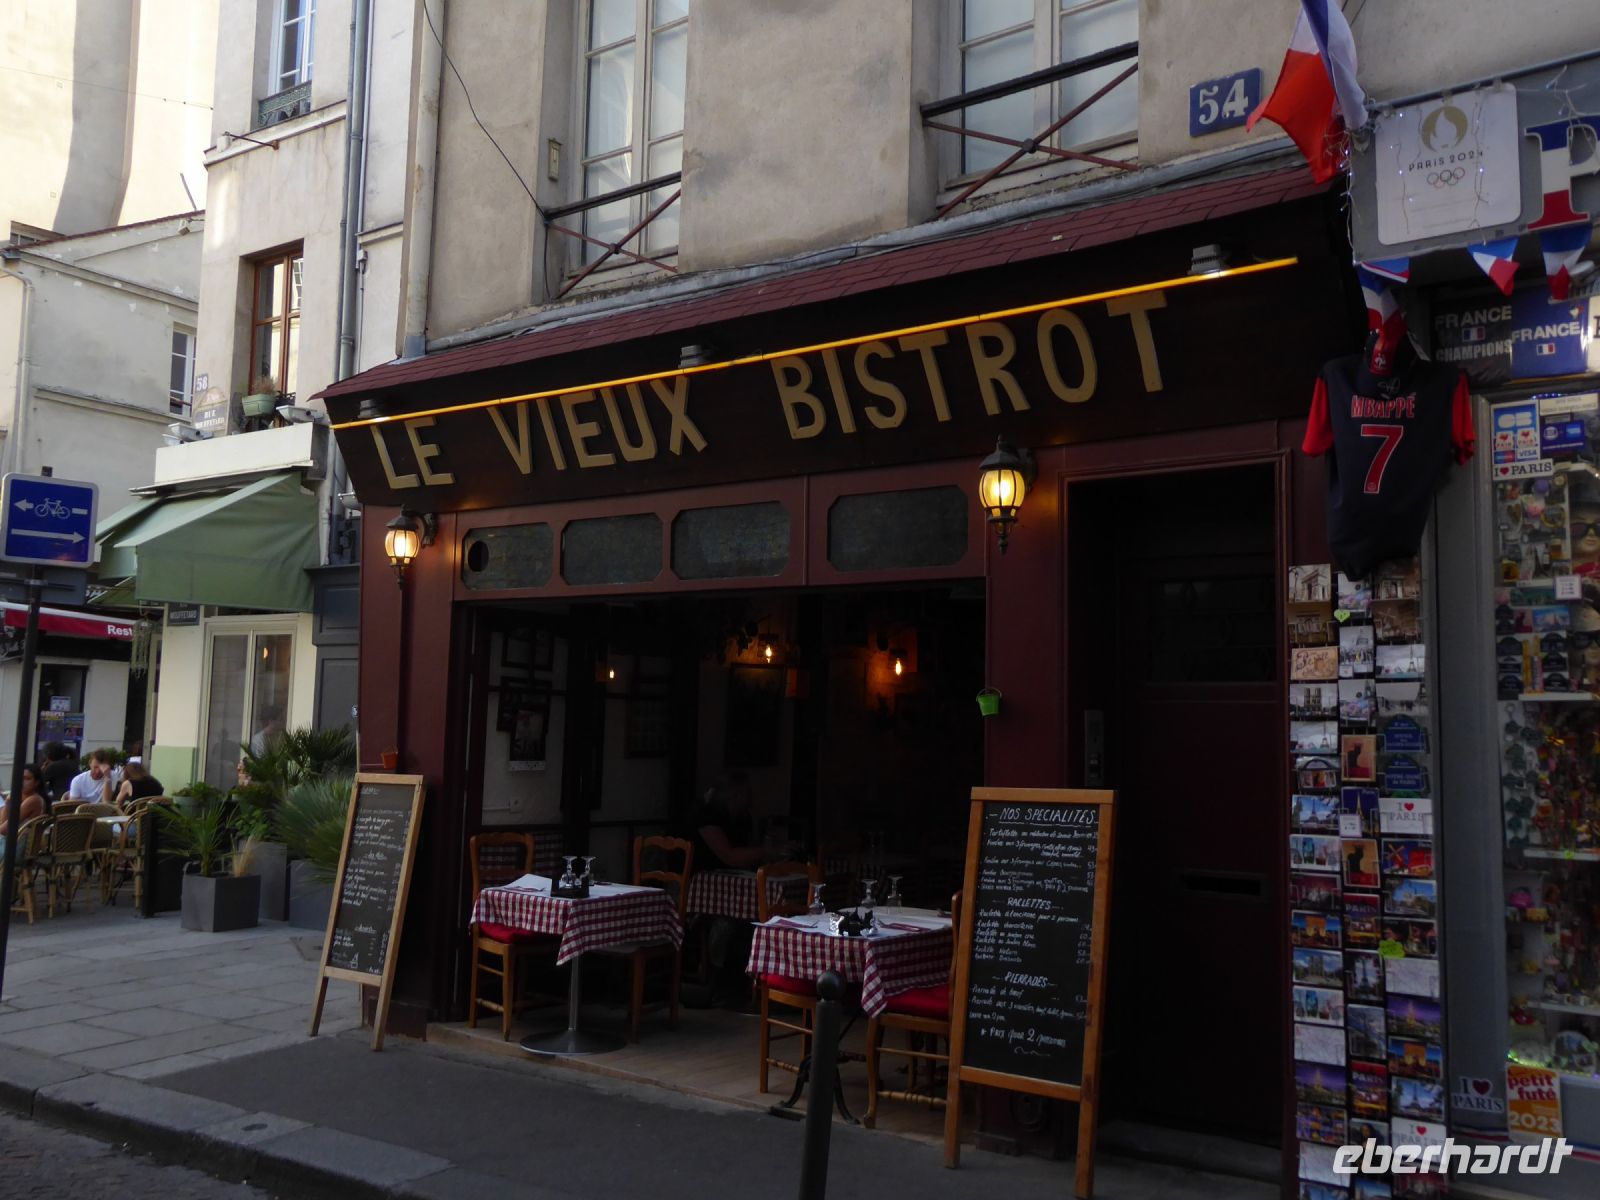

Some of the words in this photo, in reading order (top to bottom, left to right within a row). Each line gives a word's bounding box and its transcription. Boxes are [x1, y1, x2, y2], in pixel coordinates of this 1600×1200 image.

[1199, 77, 1249, 126] 54
[1408, 156, 1445, 172] PARIS
[1434, 305, 1513, 330] FRANCE
[1511, 321, 1582, 344] FRANCE
[1435, 339, 1512, 361] CHAMPIONS
[196, 376, 208, 391] 58
[370, 414, 456, 489] LE
[486, 376, 709, 476] VIEUX
[771, 289, 1168, 441] BISTROT
[1351, 392, 1416, 419] MBAPPÉ
[1361, 424, 1404, 494] 7
[1519, 449, 1537, 457] VISA
[1494, 468, 1499, 477] I
[1511, 462, 1553, 476] PARIS
[1000, 808, 1020, 821] NOS
[1025, 809, 1096, 824] SPECIALITES
[1007, 897, 1052, 910] RACLETTES
[1005, 971, 1048, 988] PIERRADES
[1027, 1028, 1035, 1042] 2
[1460, 1078, 1470, 1094] I
[1508, 1073, 1554, 1091] petit
[1453, 1094, 1503, 1111] PARIS
[1517, 1087, 1557, 1102] futé
[1508, 1111, 1561, 1133] 2023
